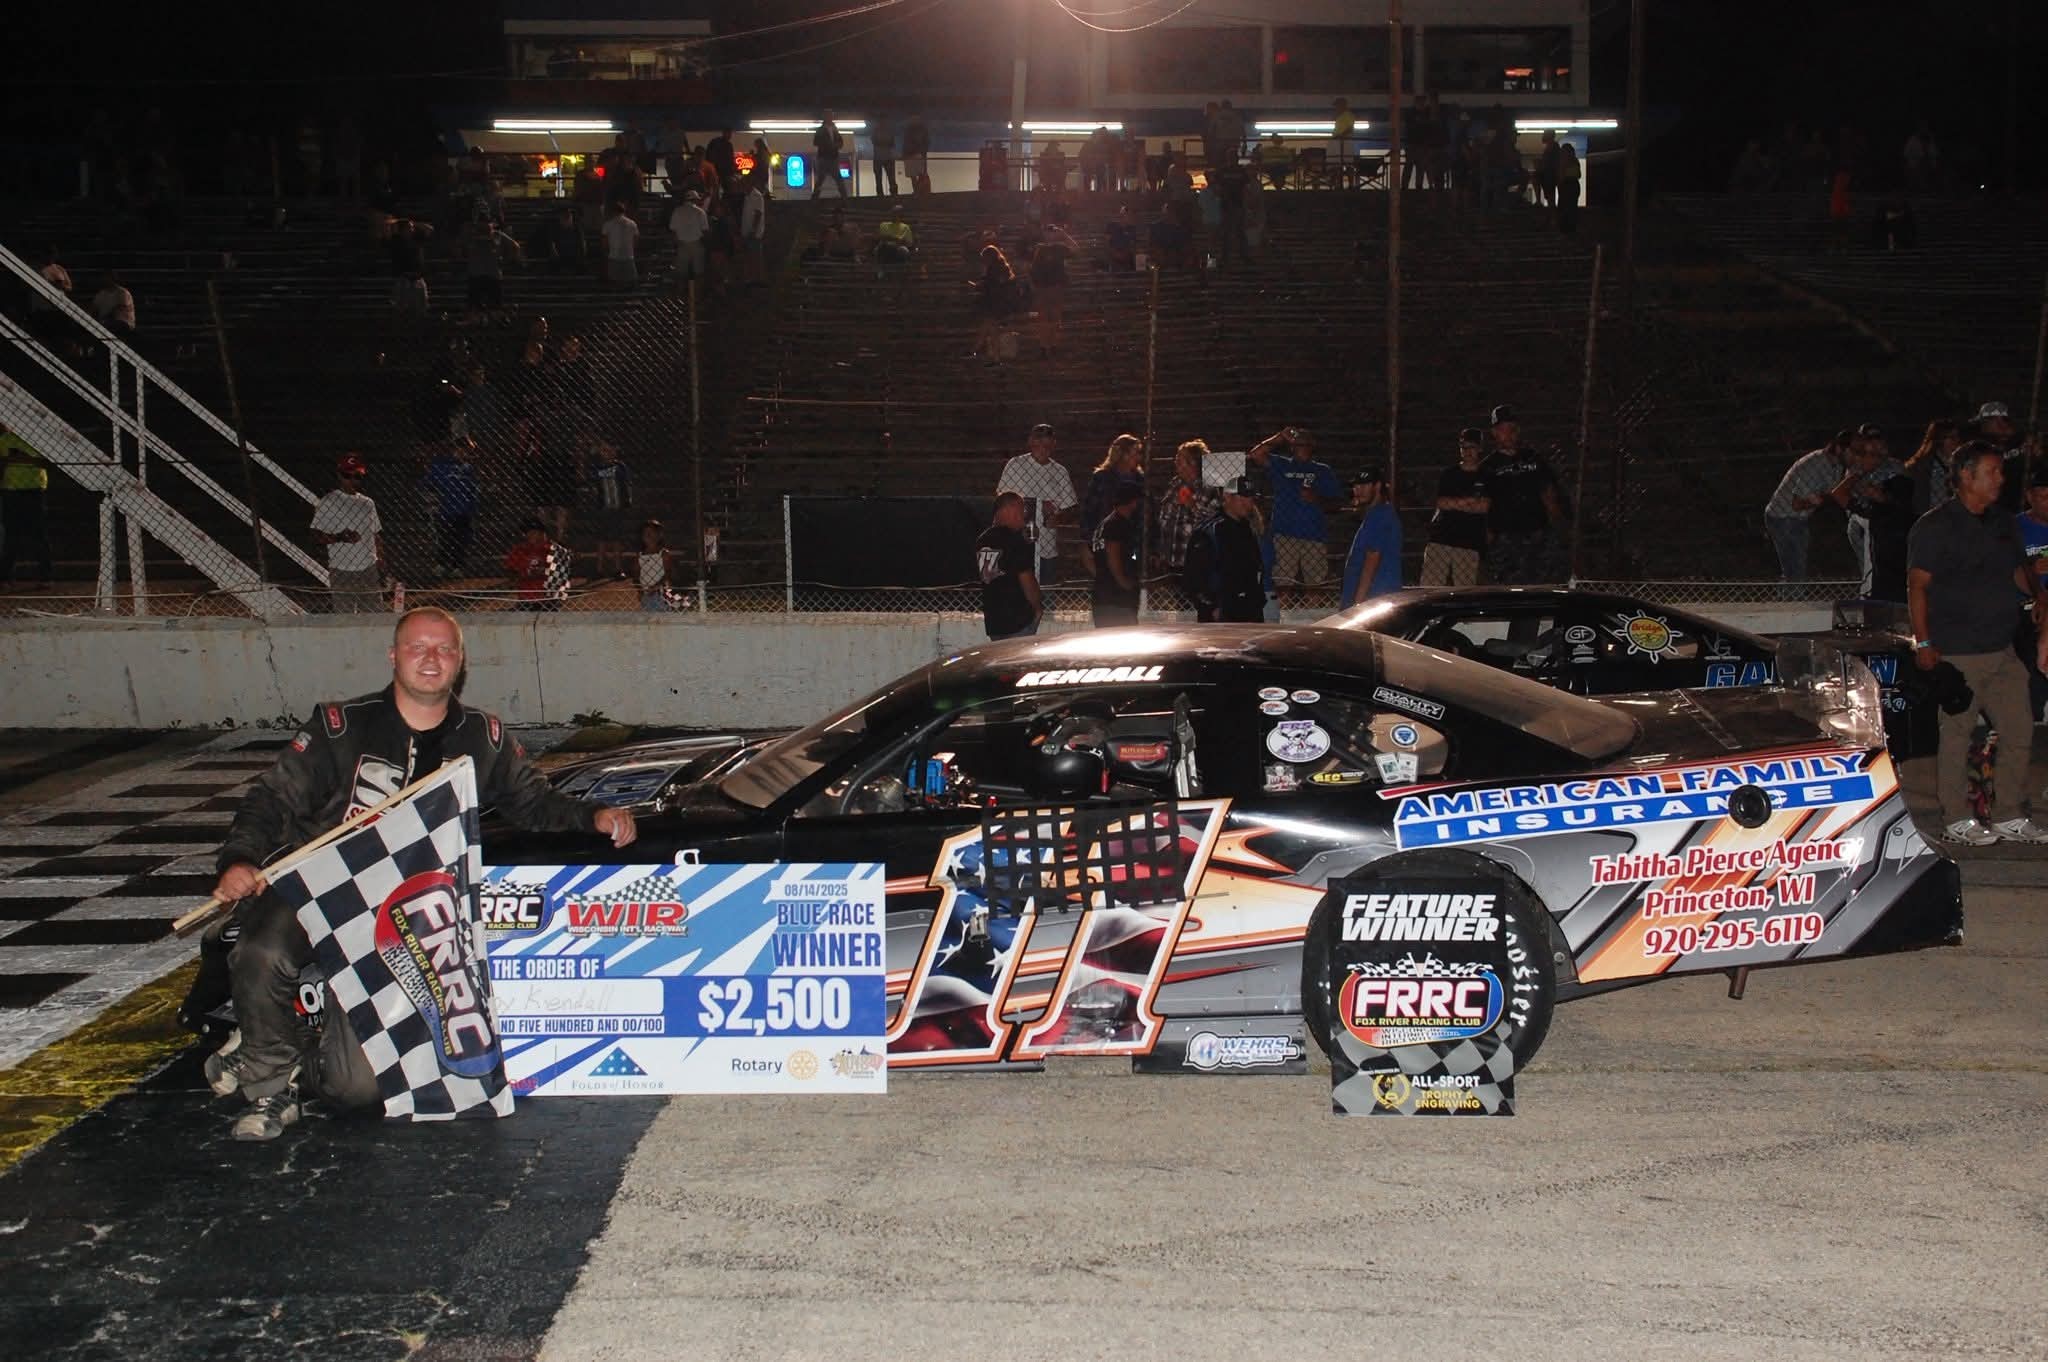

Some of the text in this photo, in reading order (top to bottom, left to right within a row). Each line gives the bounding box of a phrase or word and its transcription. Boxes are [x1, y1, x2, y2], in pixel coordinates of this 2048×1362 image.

[1016, 665, 1164, 687] KENDALL
[1398, 753, 1865, 821] AMERICAN FAMILY
[1591, 838, 1862, 883] Tabitha Pierce Agenc
[785, 884, 848, 897] 08/14/2025
[1645, 875, 1815, 916] Princeton, WI
[567, 901, 687, 927] WIR
[777, 903, 875, 926] BLUE RACE
[1342, 894, 1497, 918] FEATURE
[390, 907, 410, 933] FOX
[403, 933, 431, 971] RIVER
[568, 926, 619, 934] WISCONSIN
[643, 925, 687, 933] RACEWAY
[1341, 917, 1500, 941] WINNER
[1645, 914, 1823, 955] 920-295-6119
[772, 932, 881, 968] WINNER
[401, 890, 492, 1054] FRRC
[493, 958, 600, 979] THE ORDER OF
[1504, 914, 1539, 1028] oosier
[698, 977, 851, 1037] $2,500
[1355, 980, 1486, 1018] FRRC
[519, 1019, 541, 1033] FIVE
[545, 1018, 594, 1033] HUNDRED
[598, 1018, 619, 1032] AND
[622, 1017, 663, 1032] 00/100
[1355, 1017, 1480, 1026] FOX RIVER RACING CLUB
[1223, 1039, 1287, 1049] WEHRS
[732, 1058, 783, 1074] Rotary
[1411, 1075, 1481, 1088] ALL-SPORT
[1415, 1099, 1481, 1109] ENGRAVING
[1421, 1090, 1461, 1099] TROPHY
